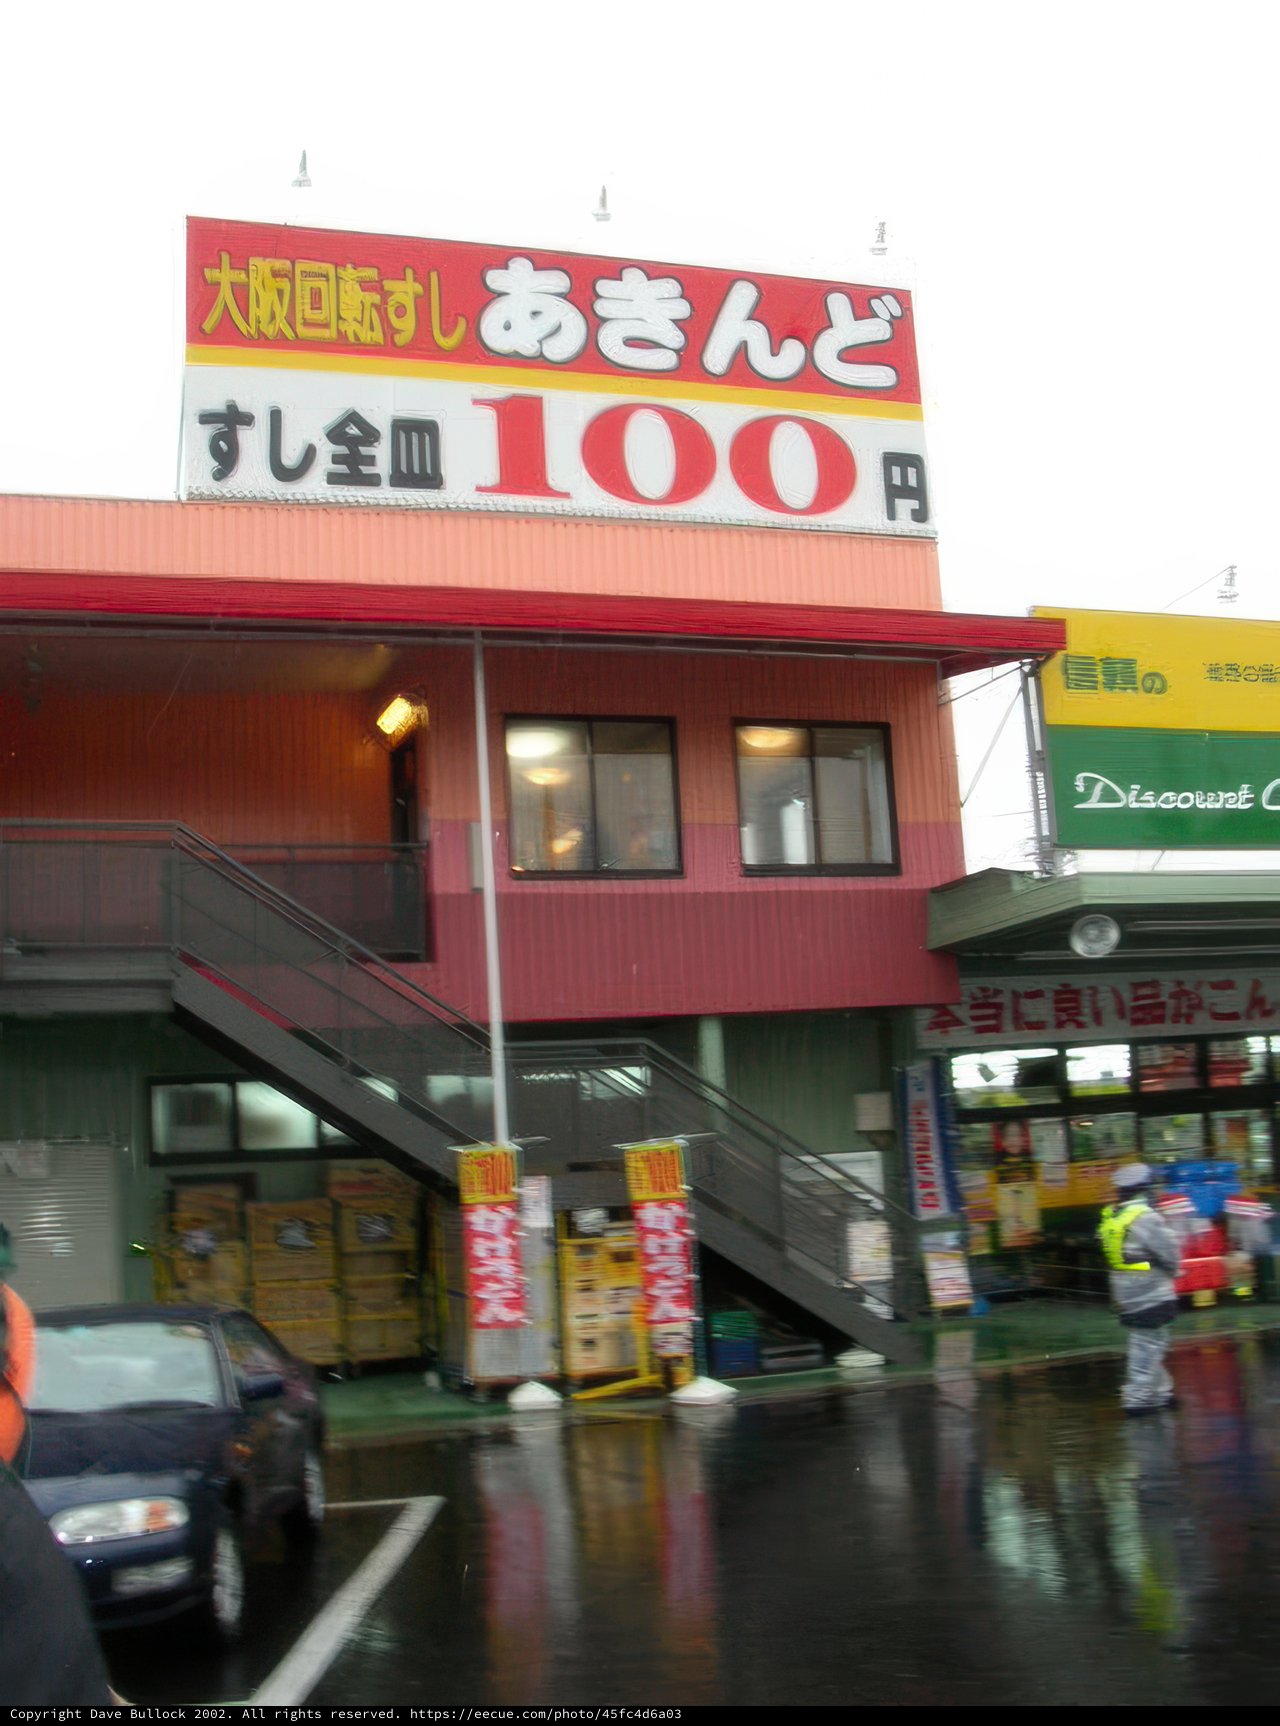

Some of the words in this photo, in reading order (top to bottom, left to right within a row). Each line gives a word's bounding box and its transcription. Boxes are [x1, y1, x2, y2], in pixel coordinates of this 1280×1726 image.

[200, 250, 467, 351] 大阪回転すし
[476, 255, 904, 389] あきんど
[1073, 772, 1255, 810] Discount
